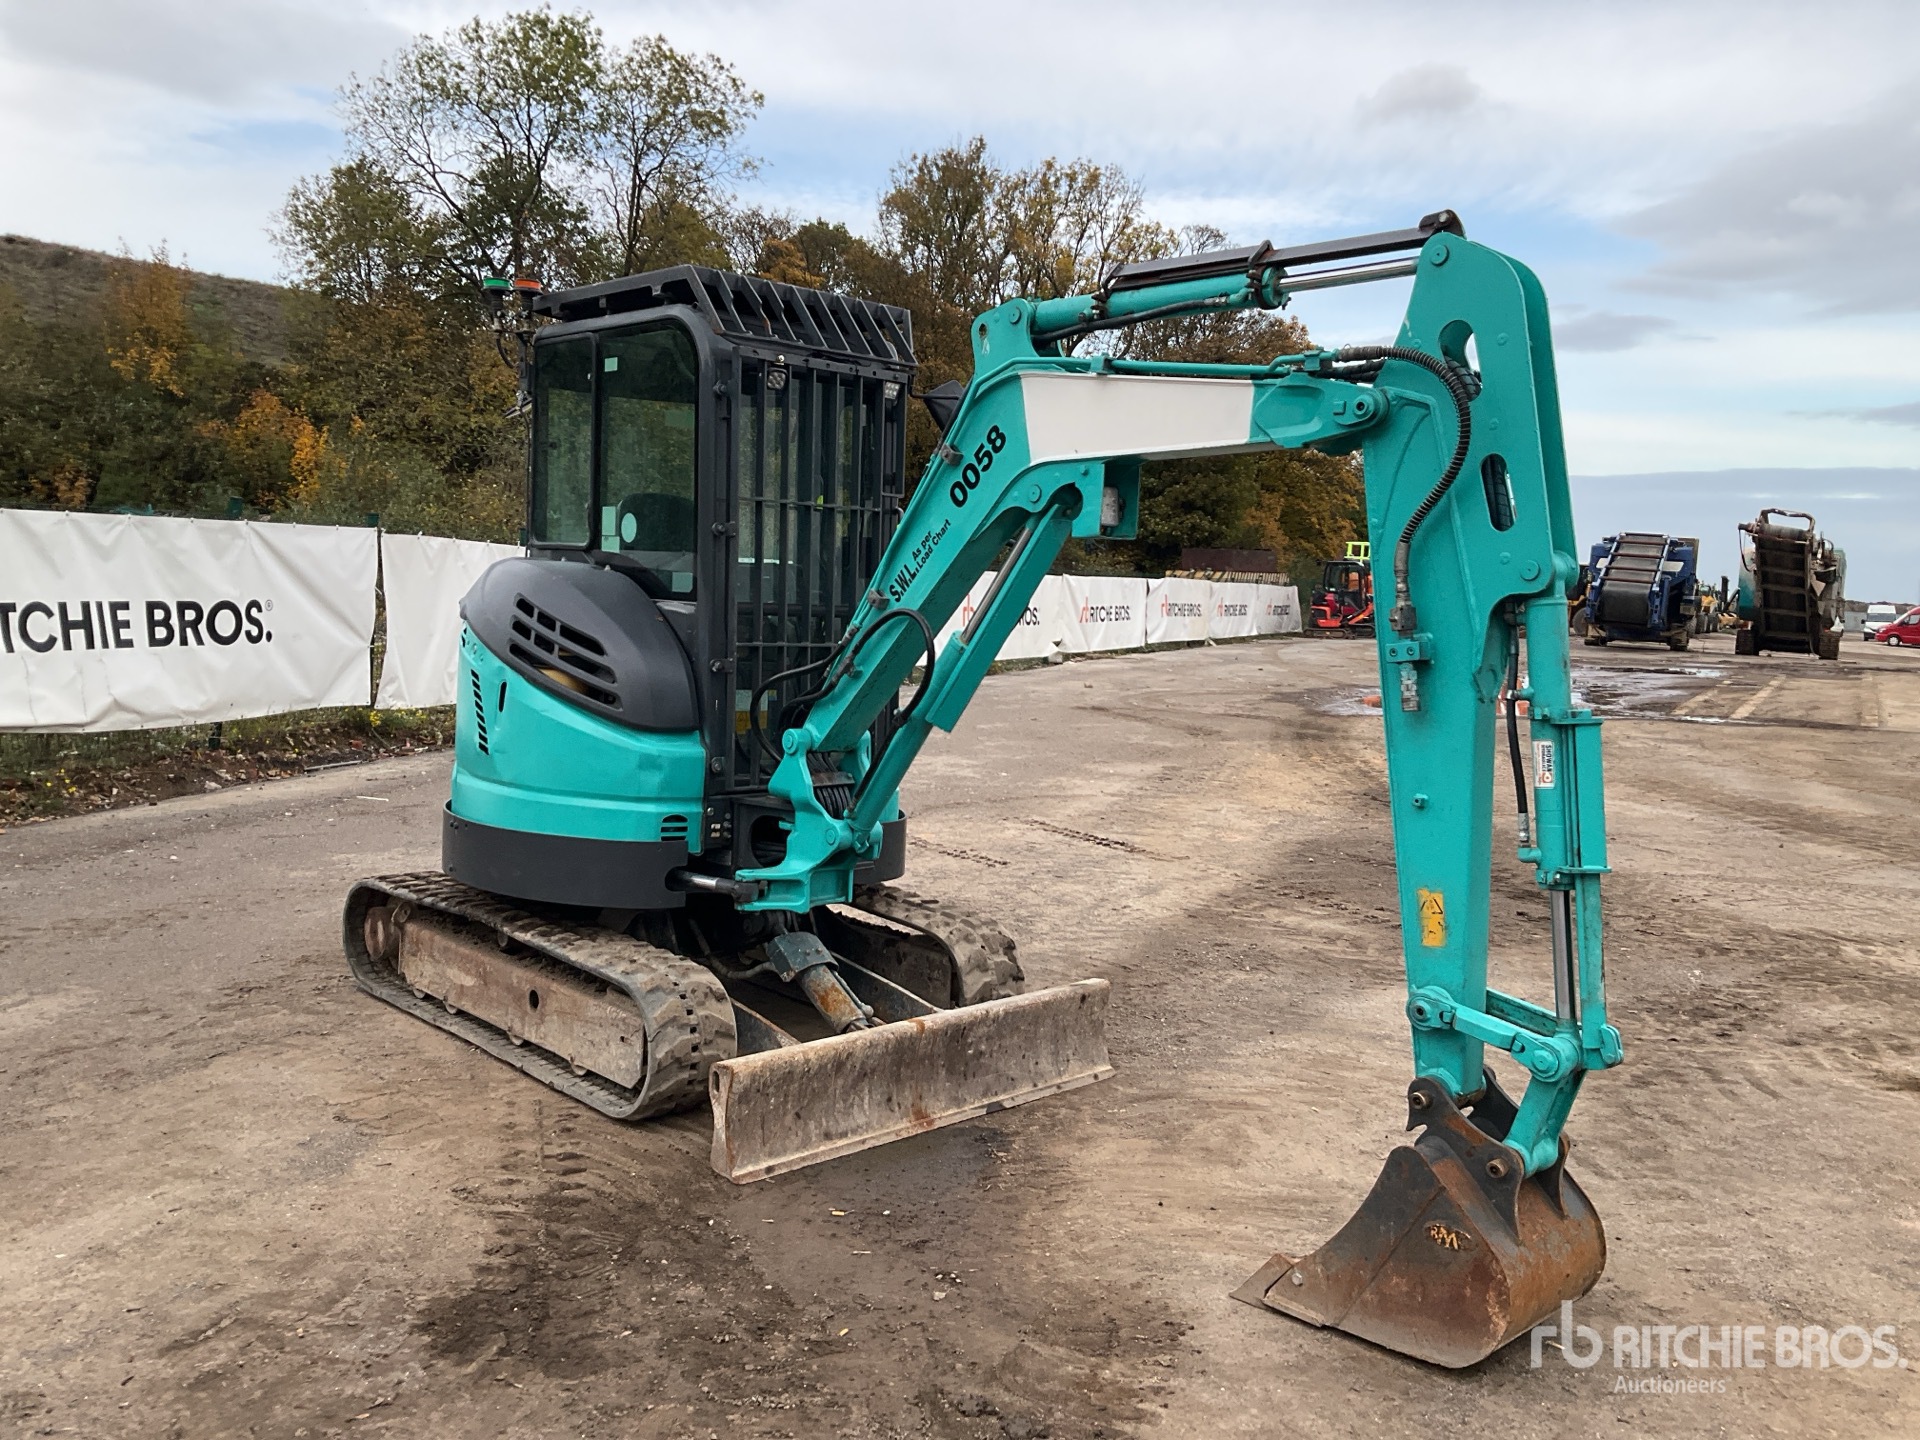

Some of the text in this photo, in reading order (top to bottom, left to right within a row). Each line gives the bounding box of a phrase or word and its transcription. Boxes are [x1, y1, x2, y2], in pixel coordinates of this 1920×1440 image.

[949, 424, 1007, 508] 0058
[911, 530, 932, 561] As per
[916, 518, 951, 569] Load Chart
